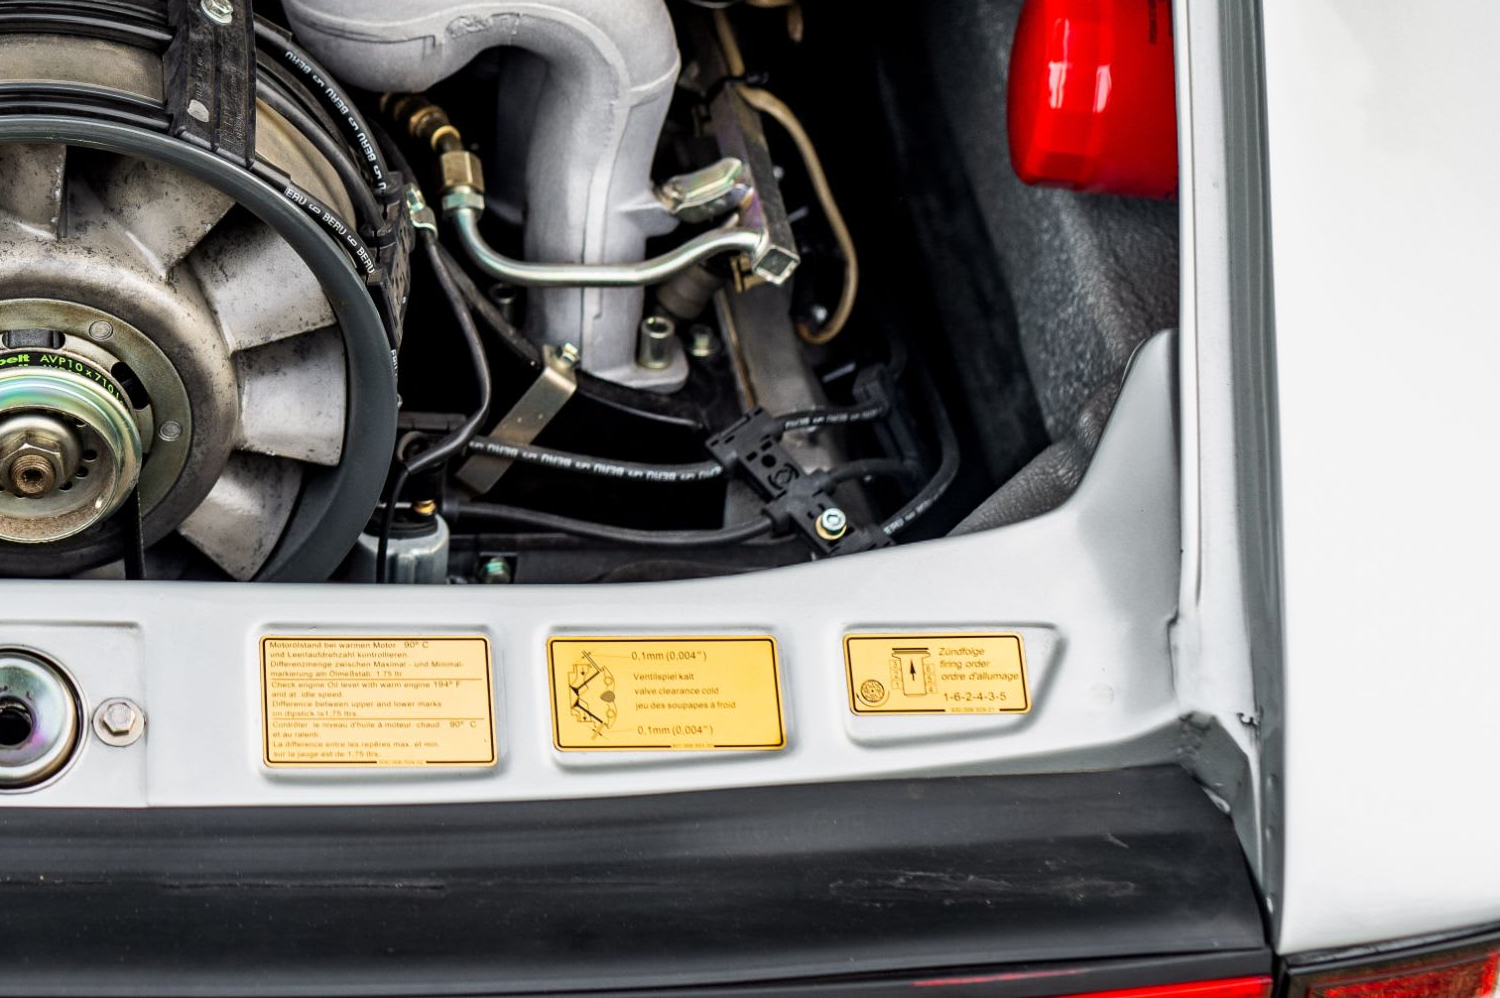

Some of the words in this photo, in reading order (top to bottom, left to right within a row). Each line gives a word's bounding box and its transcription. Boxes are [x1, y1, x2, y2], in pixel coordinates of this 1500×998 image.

[285, 51, 311, 74] BERU
[325, 88, 349, 114] BERU
[357, 132, 377, 162] BERU
[322, 212, 347, 235] BERU
[356, 246, 375, 274] BERU
[373, 641, 396, 649] Motor
[421, 641, 429, 649] C
[938, 647, 985, 657] Zündfolge
[940, 660, 962, 670] firing
[965, 660, 990, 669] order
[633, 673, 677, 682] Ventilspiel
[941, 672, 966, 682] ordre
[634, 687, 657, 695] valve
[658, 687, 700, 695] clearance
[701, 687, 719, 695] cold
[943, 692, 1007, 702] 1-6-2-4-3-5
[635, 701, 649, 711] jeu
[650, 701, 665, 709] des
[667, 702, 709, 710] soupapes
[717, 701, 736, 709] froid
